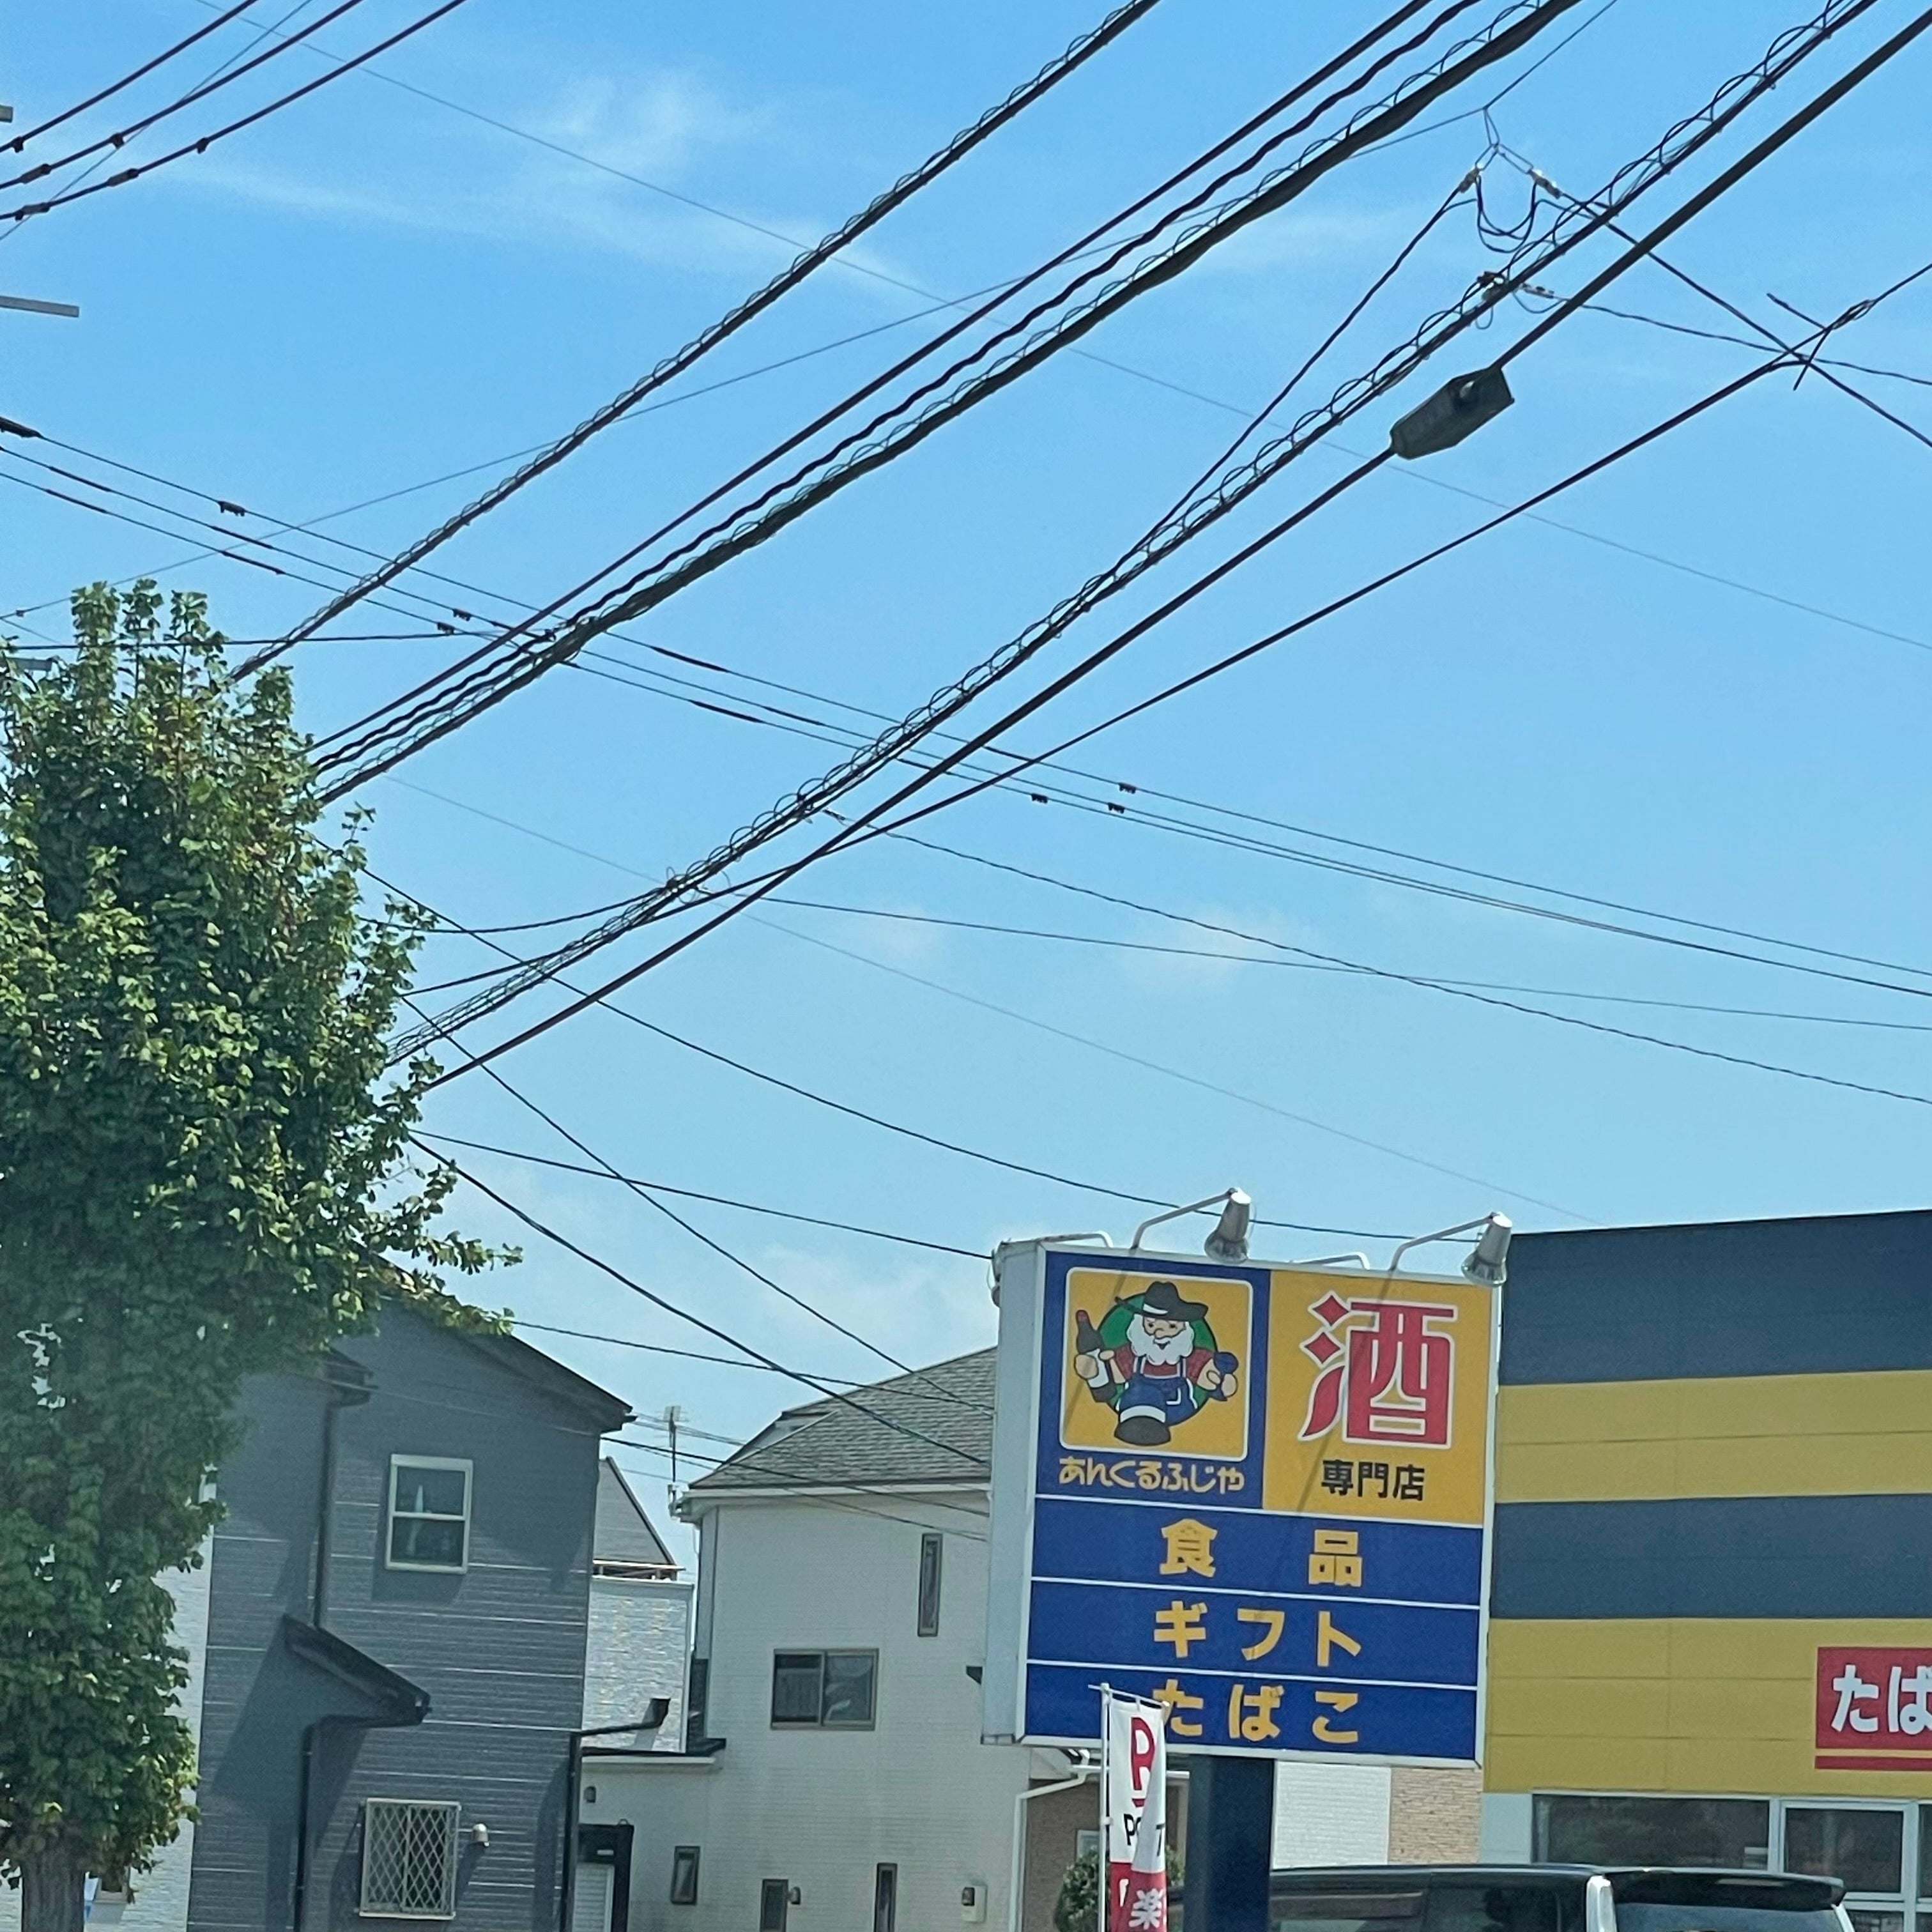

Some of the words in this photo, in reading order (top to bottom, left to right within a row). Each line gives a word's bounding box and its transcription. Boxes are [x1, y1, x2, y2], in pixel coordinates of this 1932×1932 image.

[1298, 1291, 1458, 1449] 酒
[1057, 1456, 1245, 1493] あんくるふじや
[1321, 1459, 1425, 1501] 専門店
[1159, 1518, 1362, 1588] 食品
[1153, 1600, 1361, 1668] ギフト
[1153, 1678, 1359, 1744] たばこ
